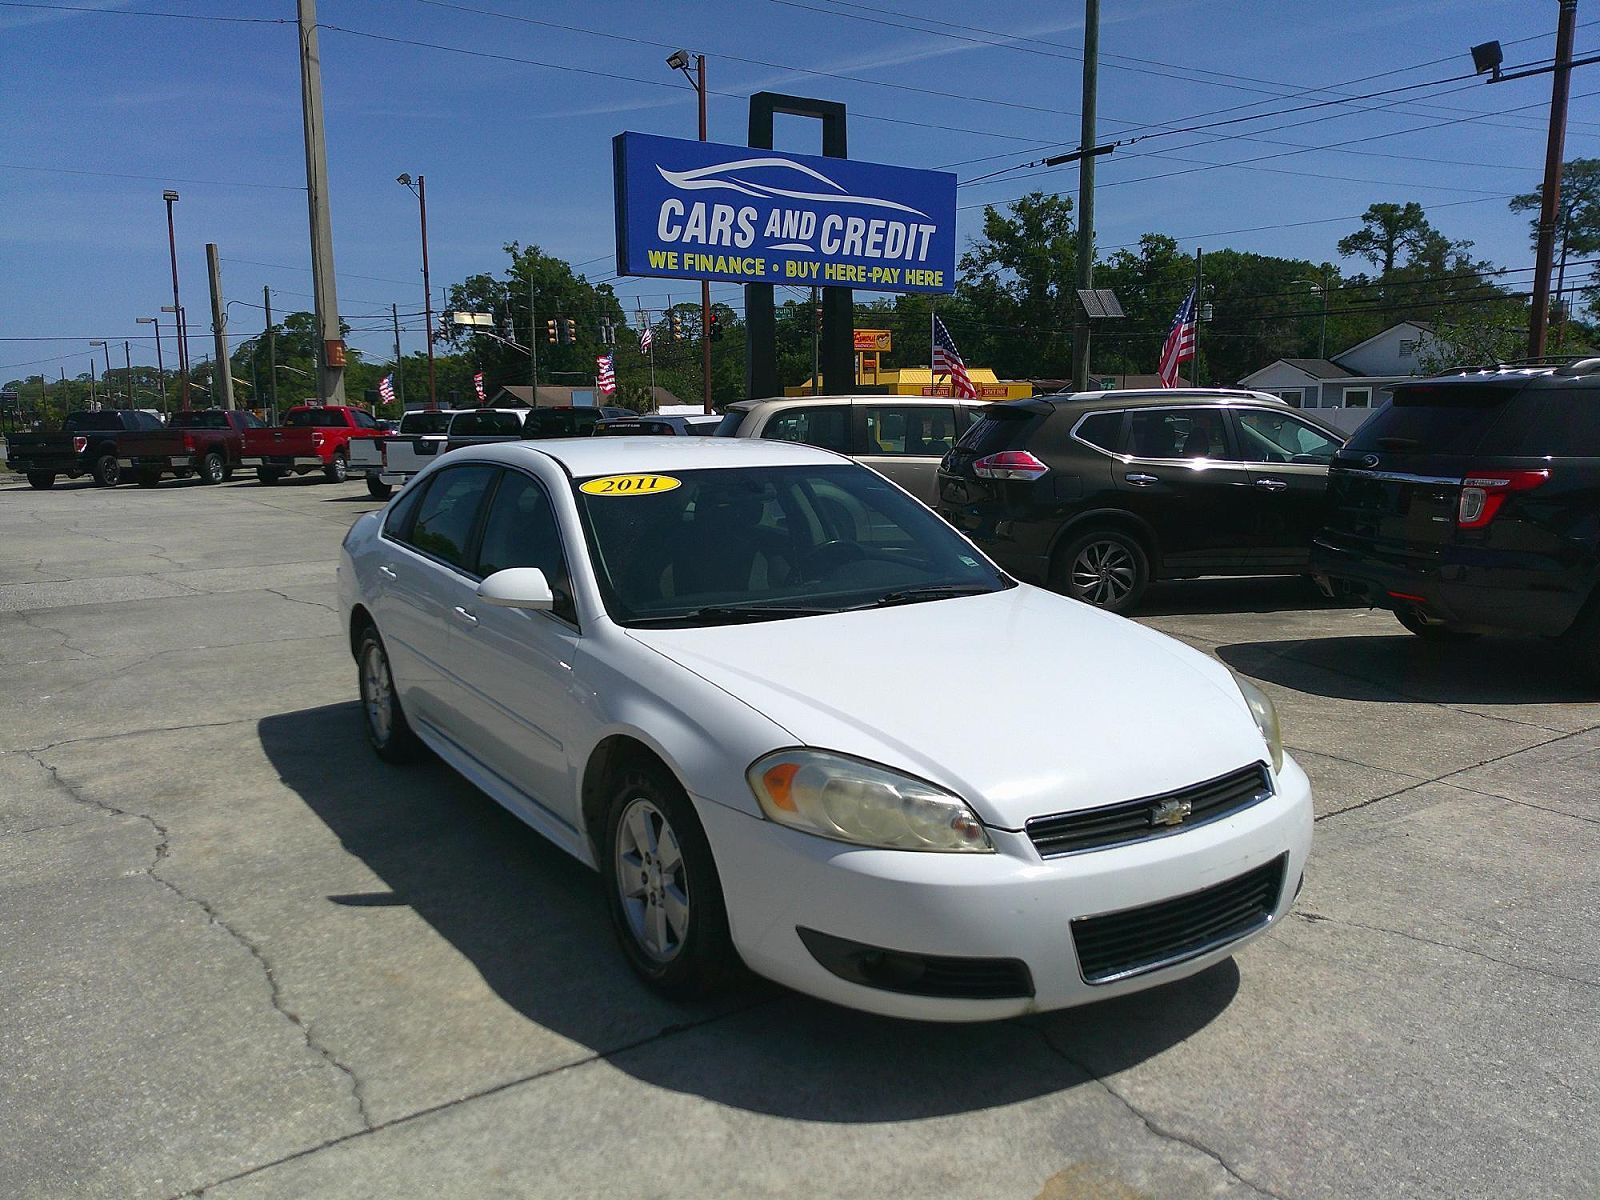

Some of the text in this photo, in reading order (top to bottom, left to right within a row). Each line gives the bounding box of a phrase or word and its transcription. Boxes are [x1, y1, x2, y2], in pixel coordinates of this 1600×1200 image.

[657, 199, 938, 262] CARS AND CREDIT
[648, 250, 679, 270] WE
[684, 253, 766, 276] FINANCE
[785, 260, 821, 279] BUY
[905, 269, 944, 287] HERE
[600, 477, 659, 493] 2011
